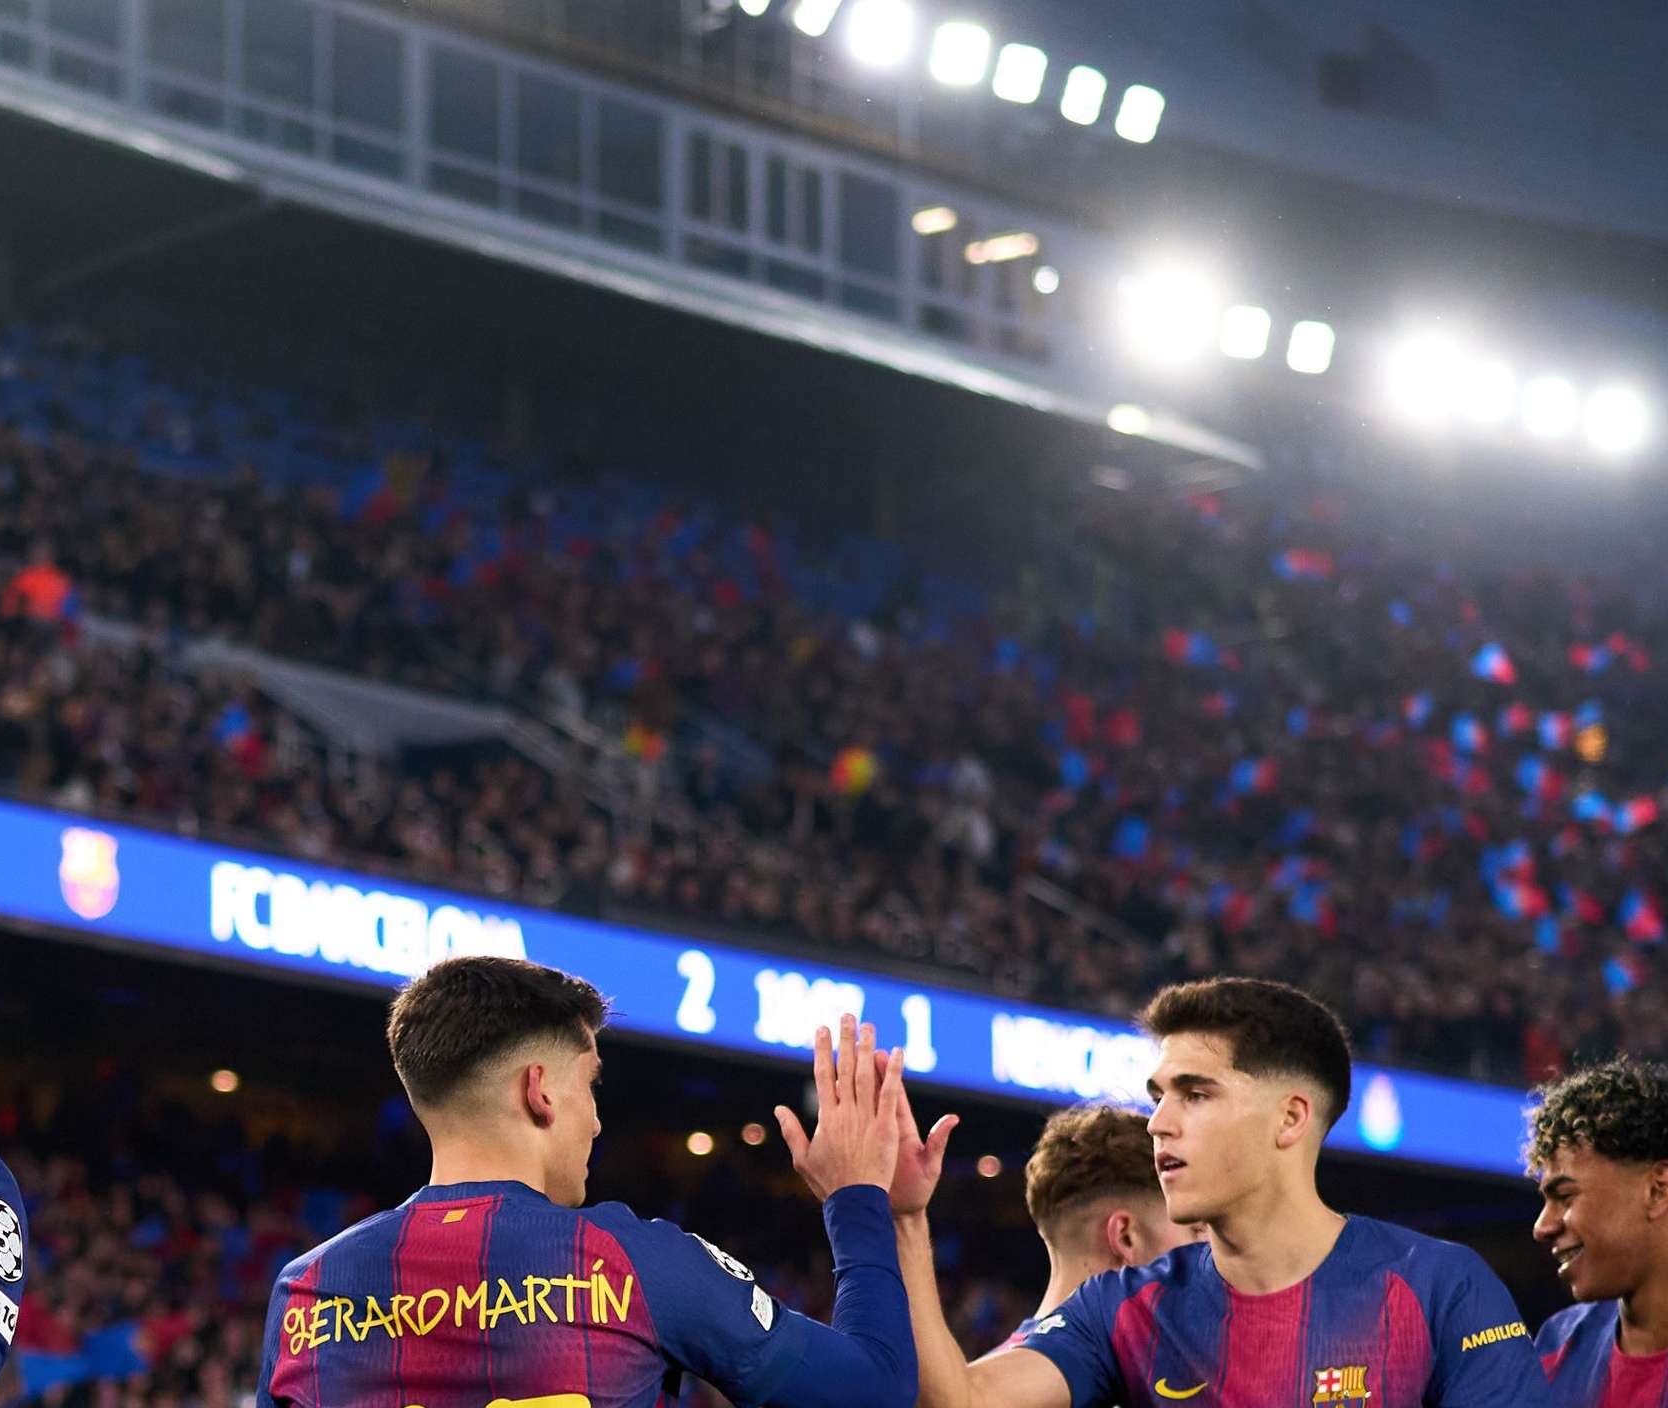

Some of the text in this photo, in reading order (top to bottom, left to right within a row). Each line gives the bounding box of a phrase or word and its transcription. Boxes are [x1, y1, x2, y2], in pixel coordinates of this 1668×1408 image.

[676, 949, 717, 1035] 2
[901, 994, 938, 1074] 1
[454, 1258, 634, 1330] MARTÍN
